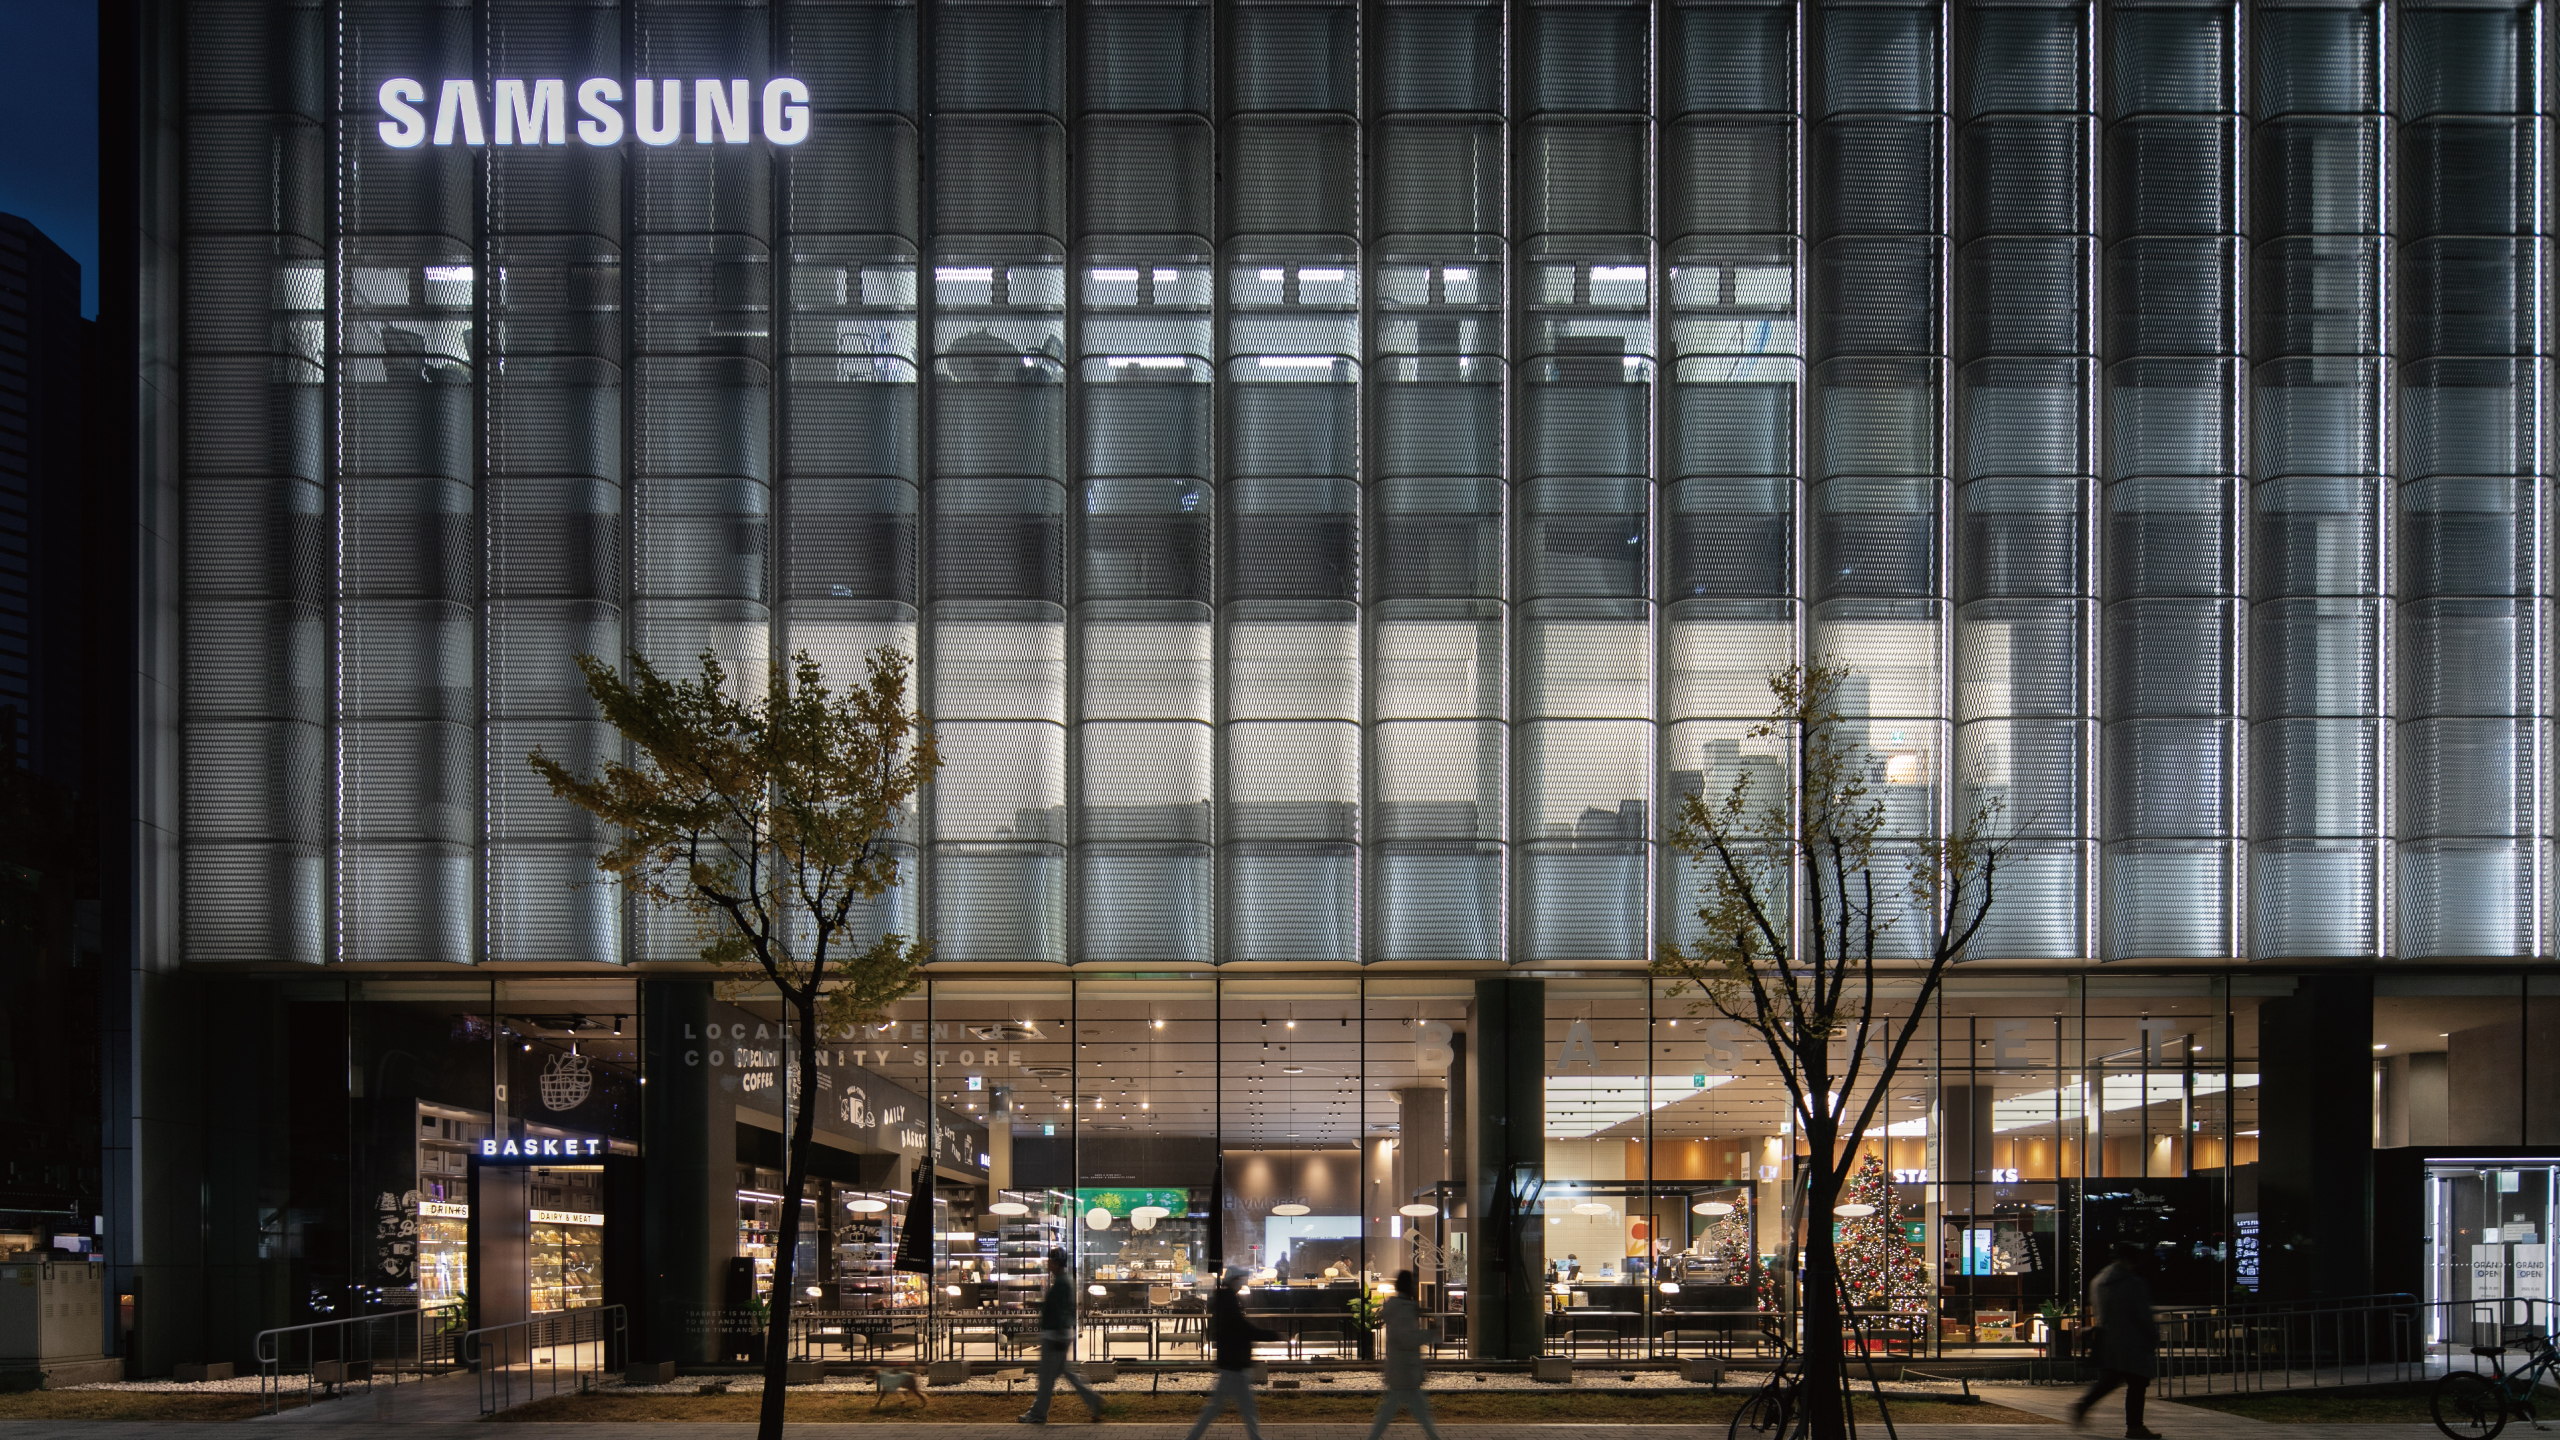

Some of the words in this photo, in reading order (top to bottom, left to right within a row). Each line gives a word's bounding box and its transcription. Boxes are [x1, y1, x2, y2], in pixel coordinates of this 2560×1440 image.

[378, 78, 810, 147] SAMSUNG
[685, 1023, 791, 1040] LOCAL
[991, 1023, 1004, 1040] &
[913, 1050, 1022, 1067] STORE
[742, 1072, 774, 1092] COFFEE
[883, 1105, 905, 1125] DAILY
[901, 1128, 927, 1148] BASKET
[482, 1138, 600, 1156] BASKET
[1895, 1168, 2020, 1184] STAKS
[430, 1204, 468, 1216] DRINKS
[540, 1212, 563, 1221] DAIRY
[565, 1213, 571, 1222] &
[573, 1214, 592, 1223] MEAT
[834, 1225, 857, 1238] LET'S
[2473, 1261, 2504, 1270] GRAND
[2515, 1261, 2545, 1270] GRAND
[2477, 1270, 2499, 1278] OPEN
[2519, 1270, 2541, 1278] OPEN
